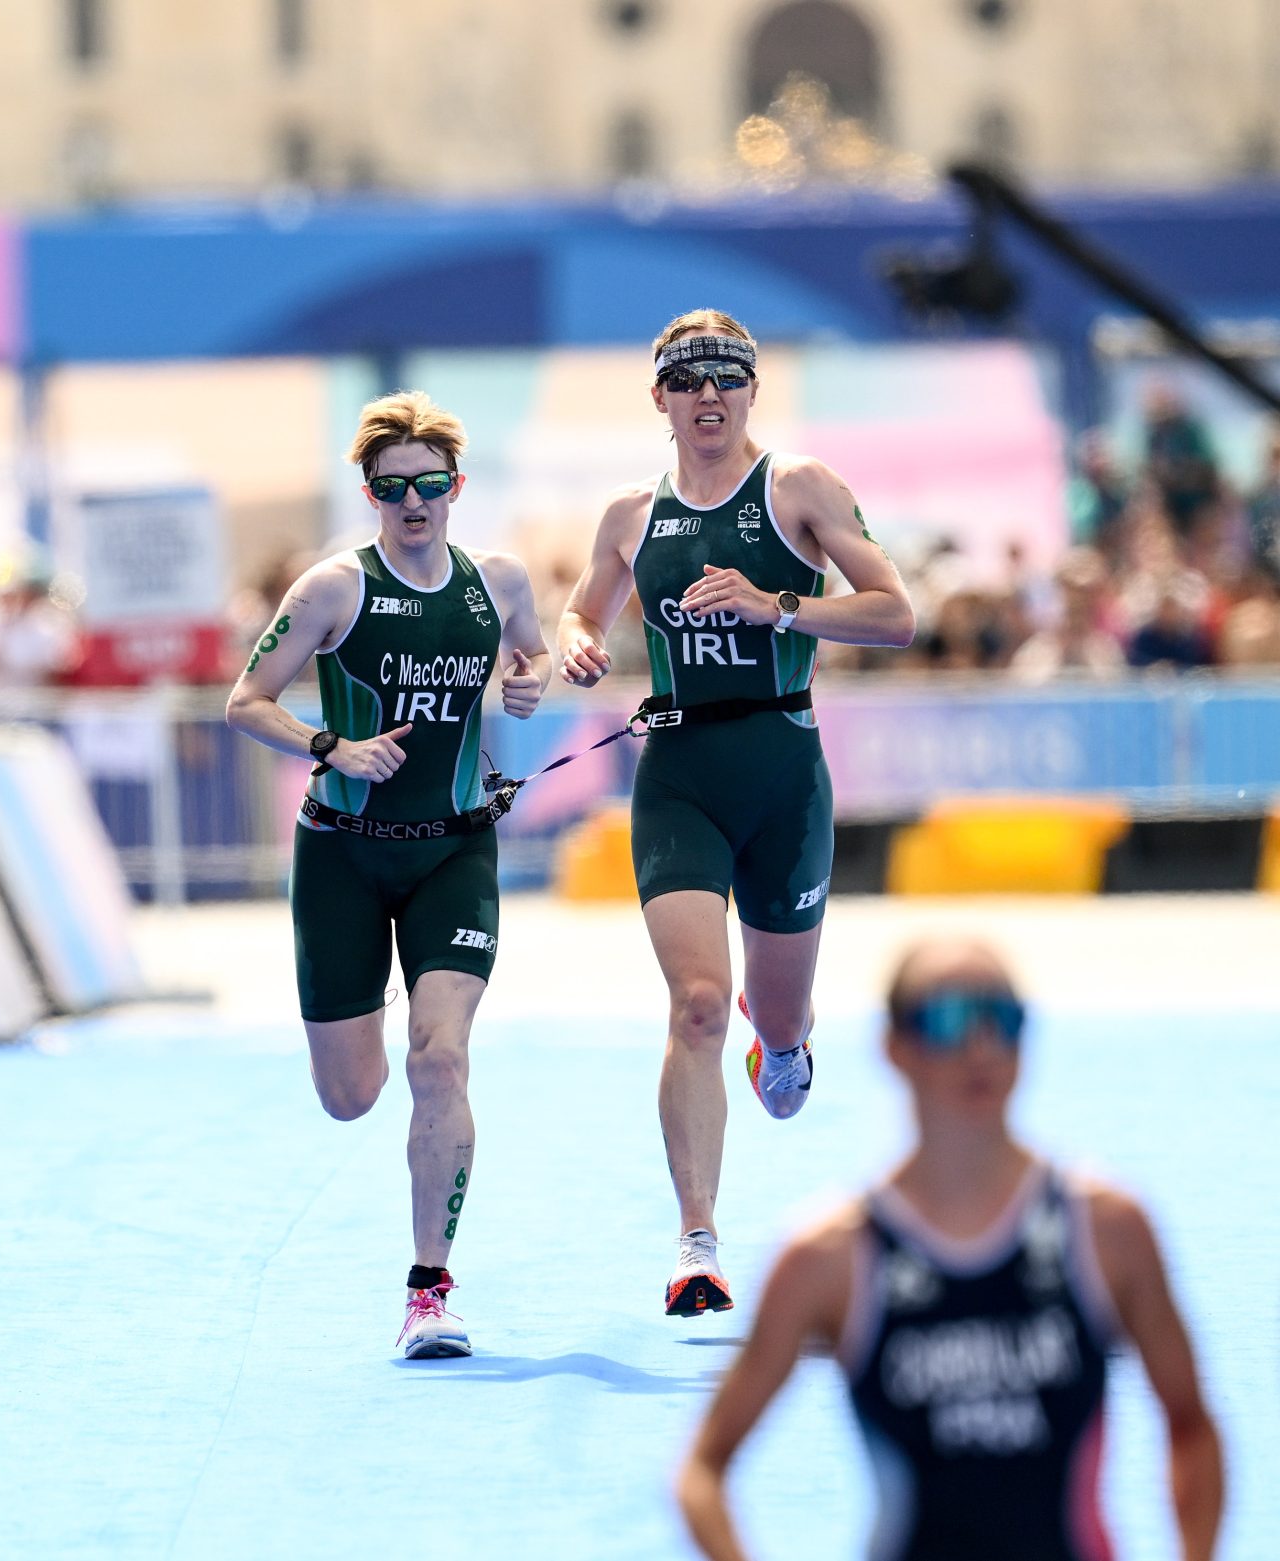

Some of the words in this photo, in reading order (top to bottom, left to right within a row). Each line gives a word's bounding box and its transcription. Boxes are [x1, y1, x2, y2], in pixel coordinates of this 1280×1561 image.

[660, 598, 754, 628] GUID
[682, 632, 757, 665] IRL
[380, 652, 393, 685] C
[398, 653, 488, 687] MacCOMBE
[394, 692, 461, 722] IRL
[444, 1167, 467, 1240] 608
